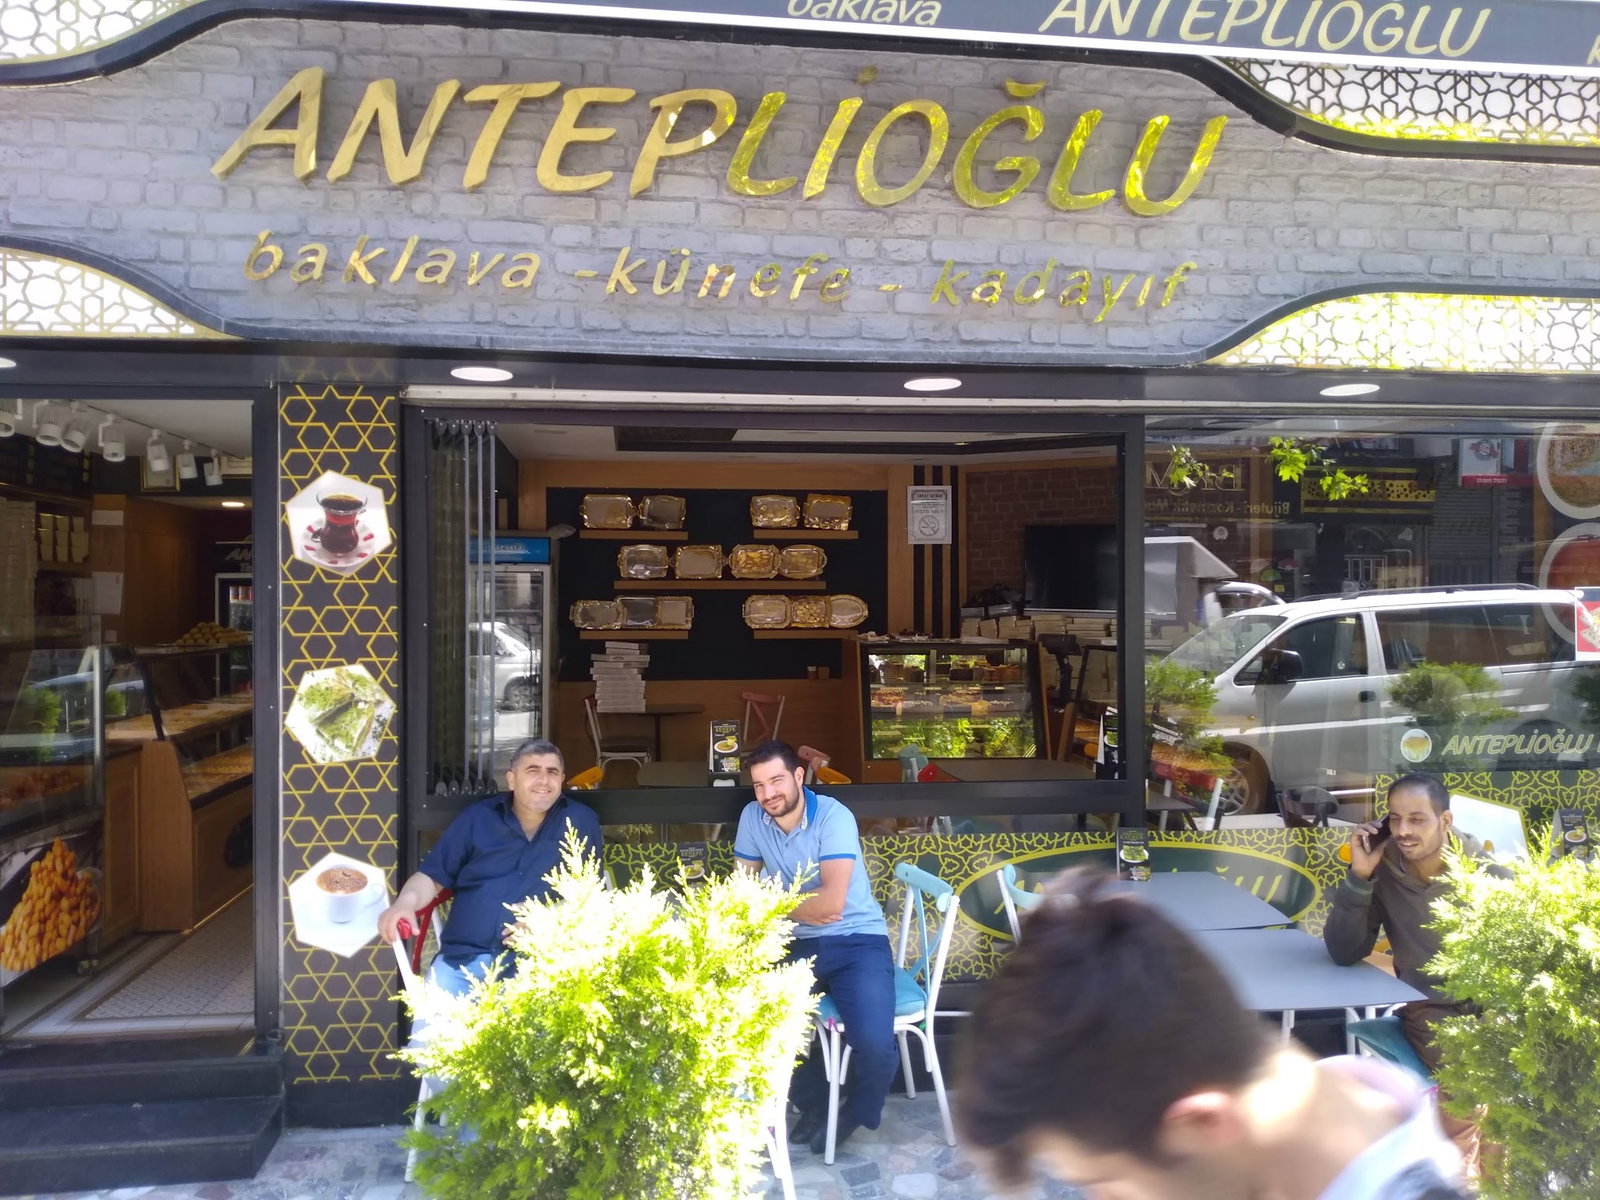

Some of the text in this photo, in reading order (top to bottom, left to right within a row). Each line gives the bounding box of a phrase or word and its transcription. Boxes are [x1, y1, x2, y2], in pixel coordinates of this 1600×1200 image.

[211, 65, 1229, 217] ANTEPLİOĞLU
[242, 229, 542, 289] baklava
[930, 258, 1198, 322] kadayıf
[1441, 729, 1595, 755] ANTEPLİOĞLU
